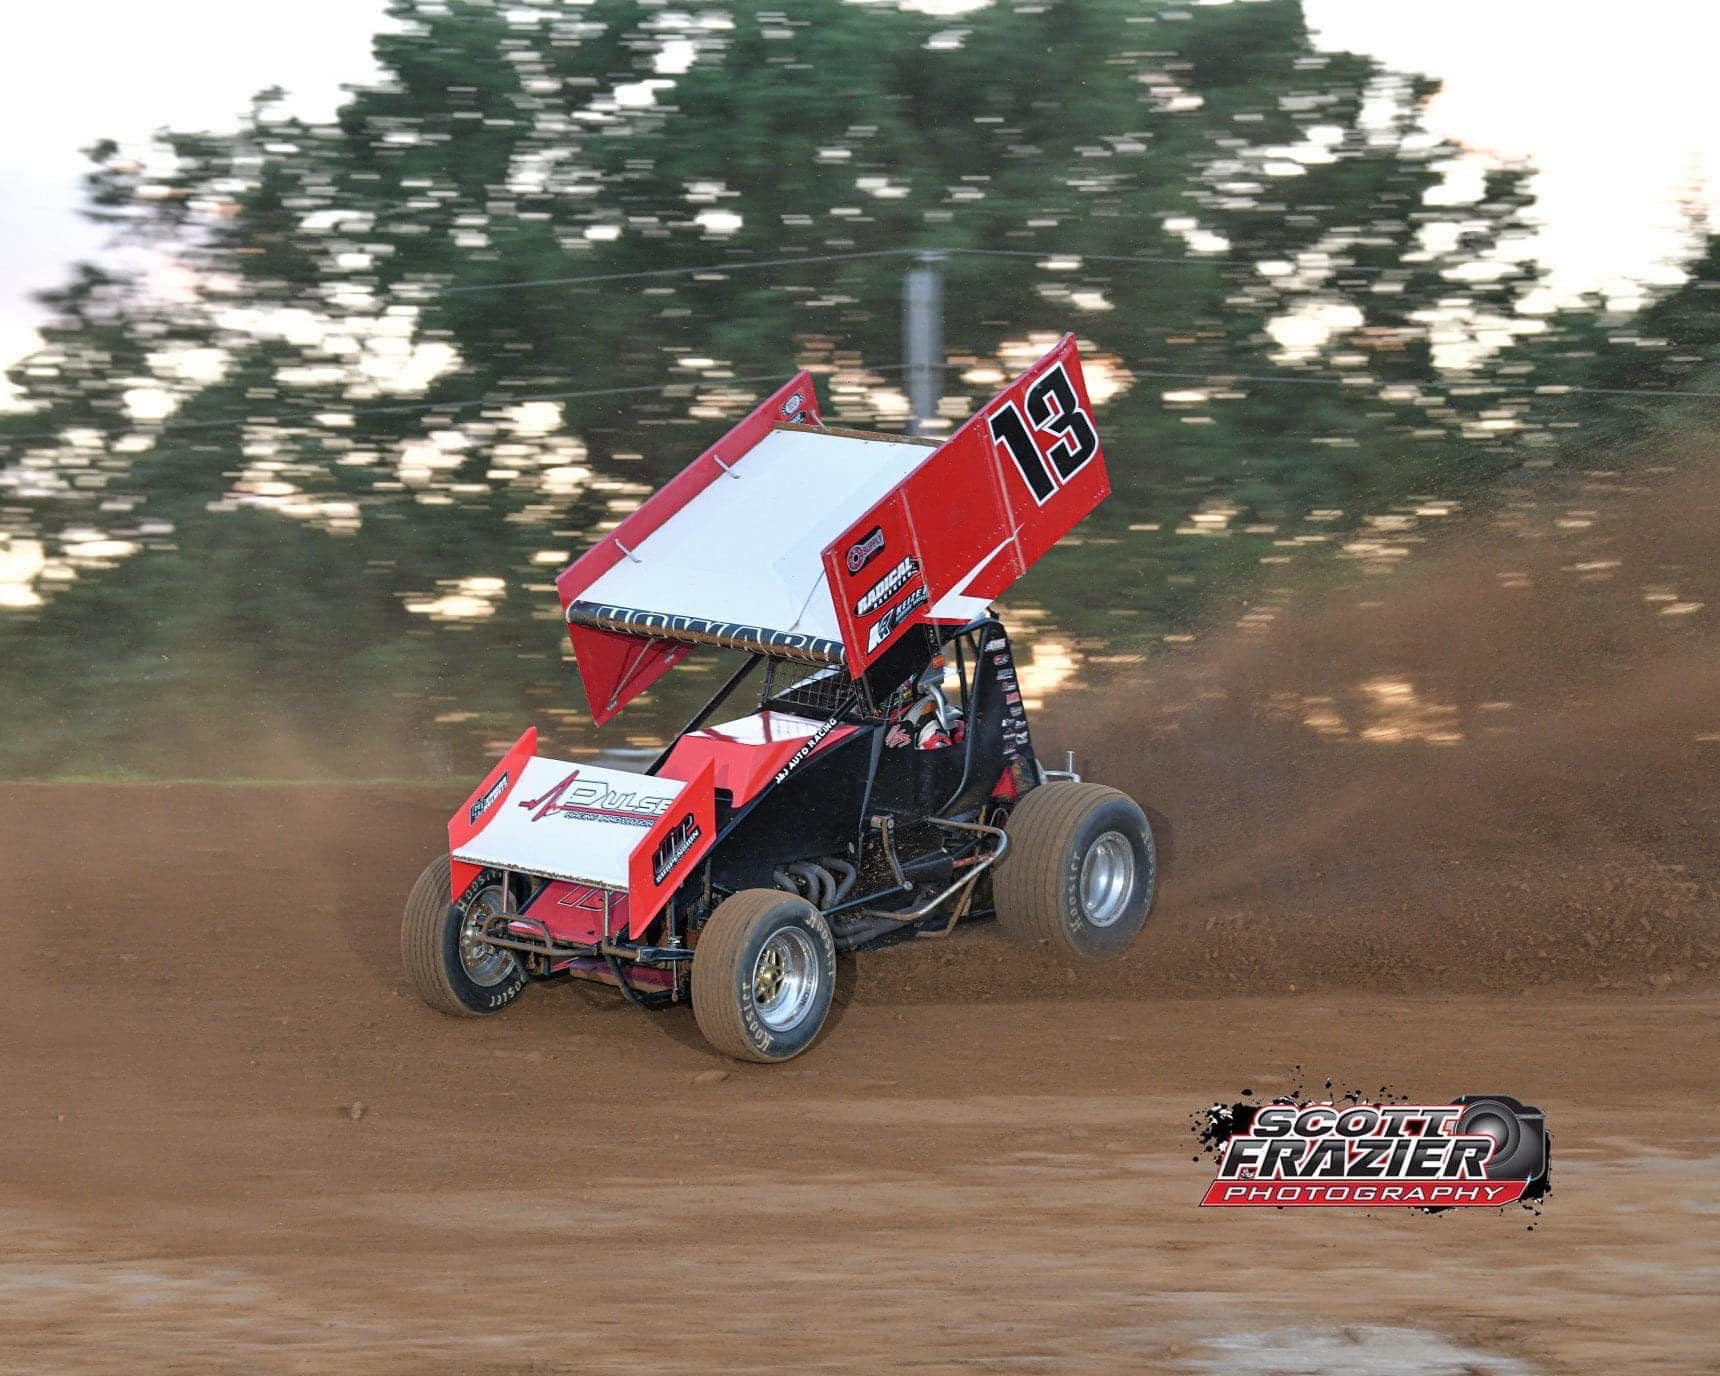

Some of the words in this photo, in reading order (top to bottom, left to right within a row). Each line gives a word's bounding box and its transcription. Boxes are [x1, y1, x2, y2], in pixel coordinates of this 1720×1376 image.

[988, 360, 1099, 507] 13
[857, 556, 914, 616] RADICAL
[788, 747, 809, 770] AUTO
[807, 717, 837, 748] RACING
